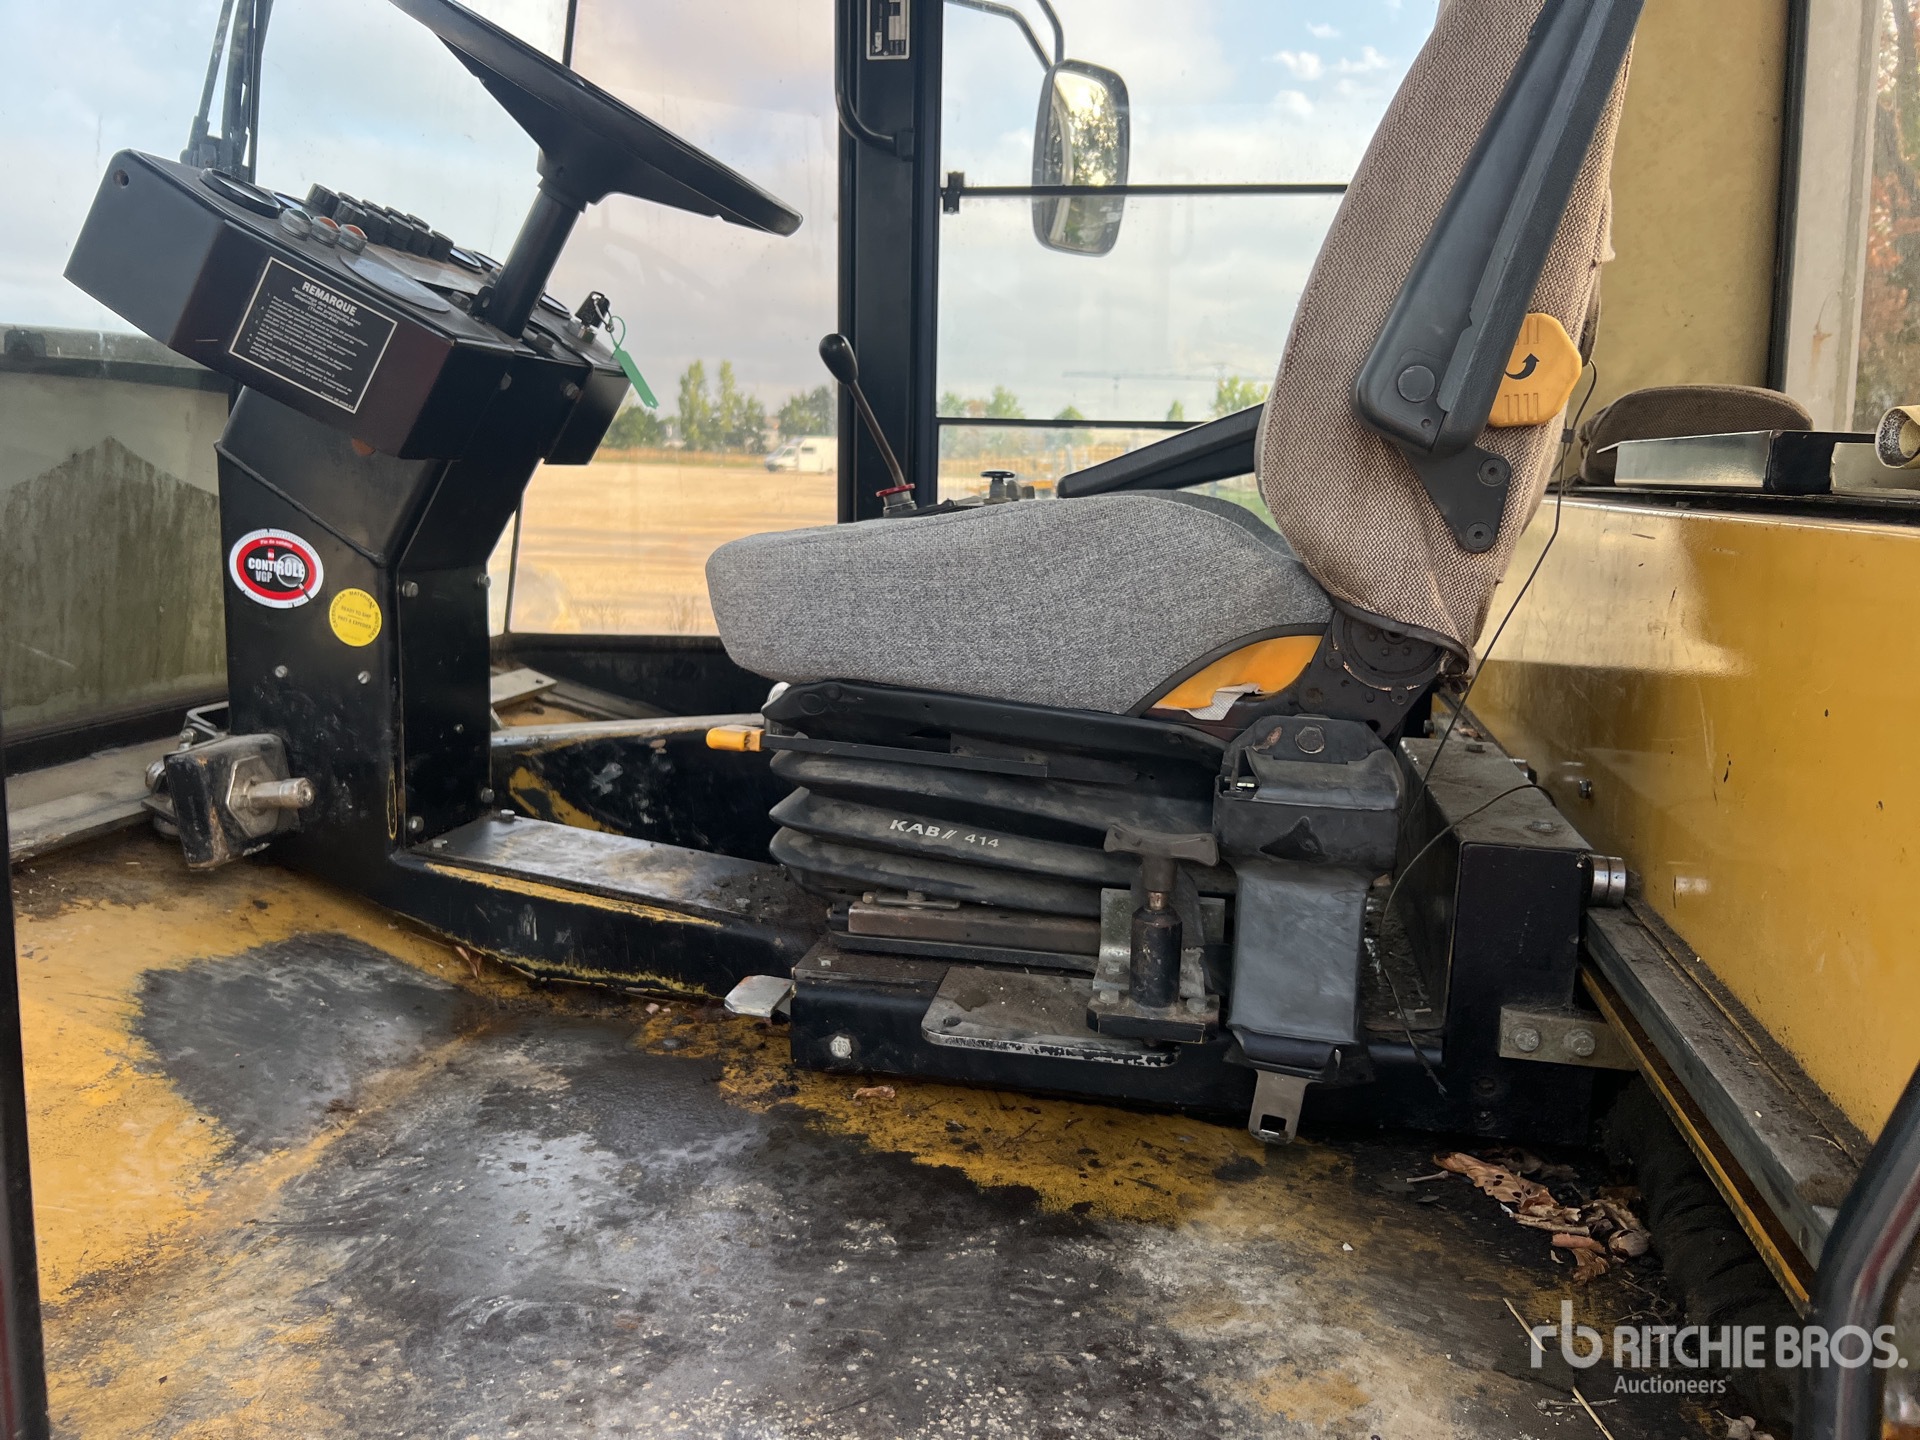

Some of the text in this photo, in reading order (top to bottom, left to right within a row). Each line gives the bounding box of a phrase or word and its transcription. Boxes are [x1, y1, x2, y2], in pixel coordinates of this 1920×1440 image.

[301, 280, 357, 316] REMARQUE
[255, 570, 273, 583] VGP
[964, 833, 999, 848] 414
